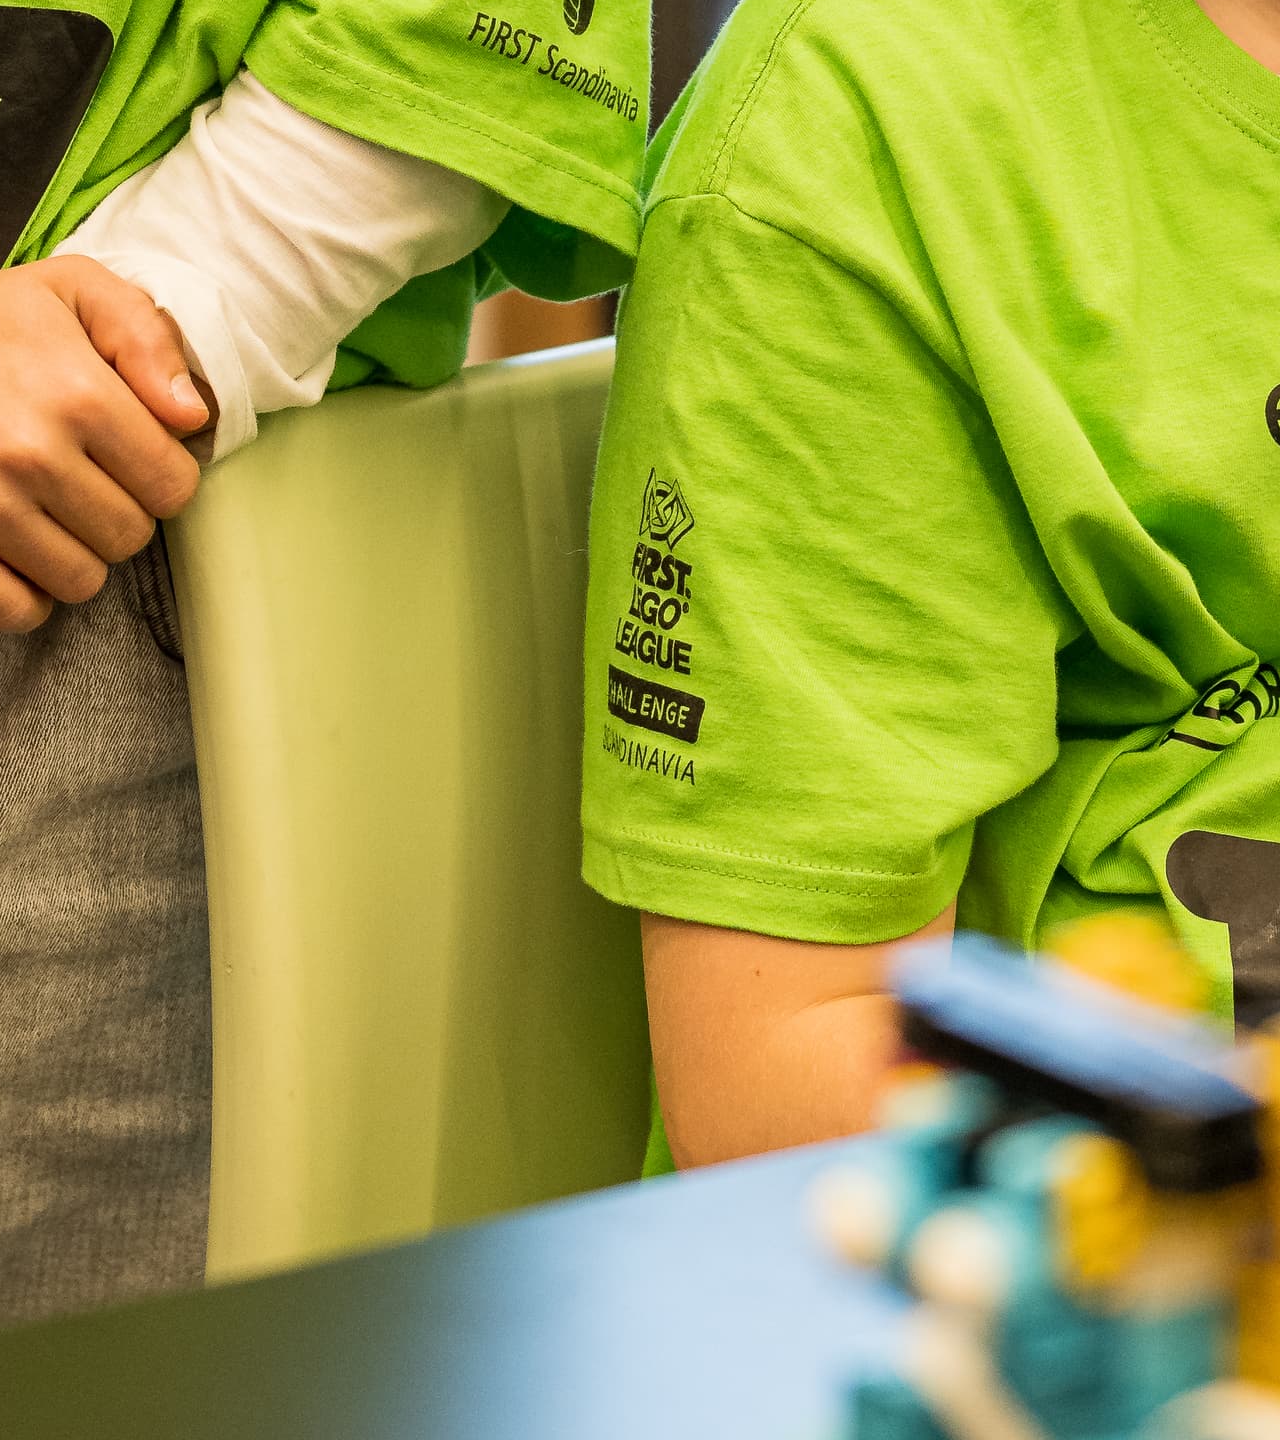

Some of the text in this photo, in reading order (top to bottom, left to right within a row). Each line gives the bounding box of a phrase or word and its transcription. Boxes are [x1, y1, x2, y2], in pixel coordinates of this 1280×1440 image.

[467, 11, 639, 122] FIRST Scandinavia
[615, 617, 693, 675] LEAGUE
[609, 678, 691, 729] HALLENGE
